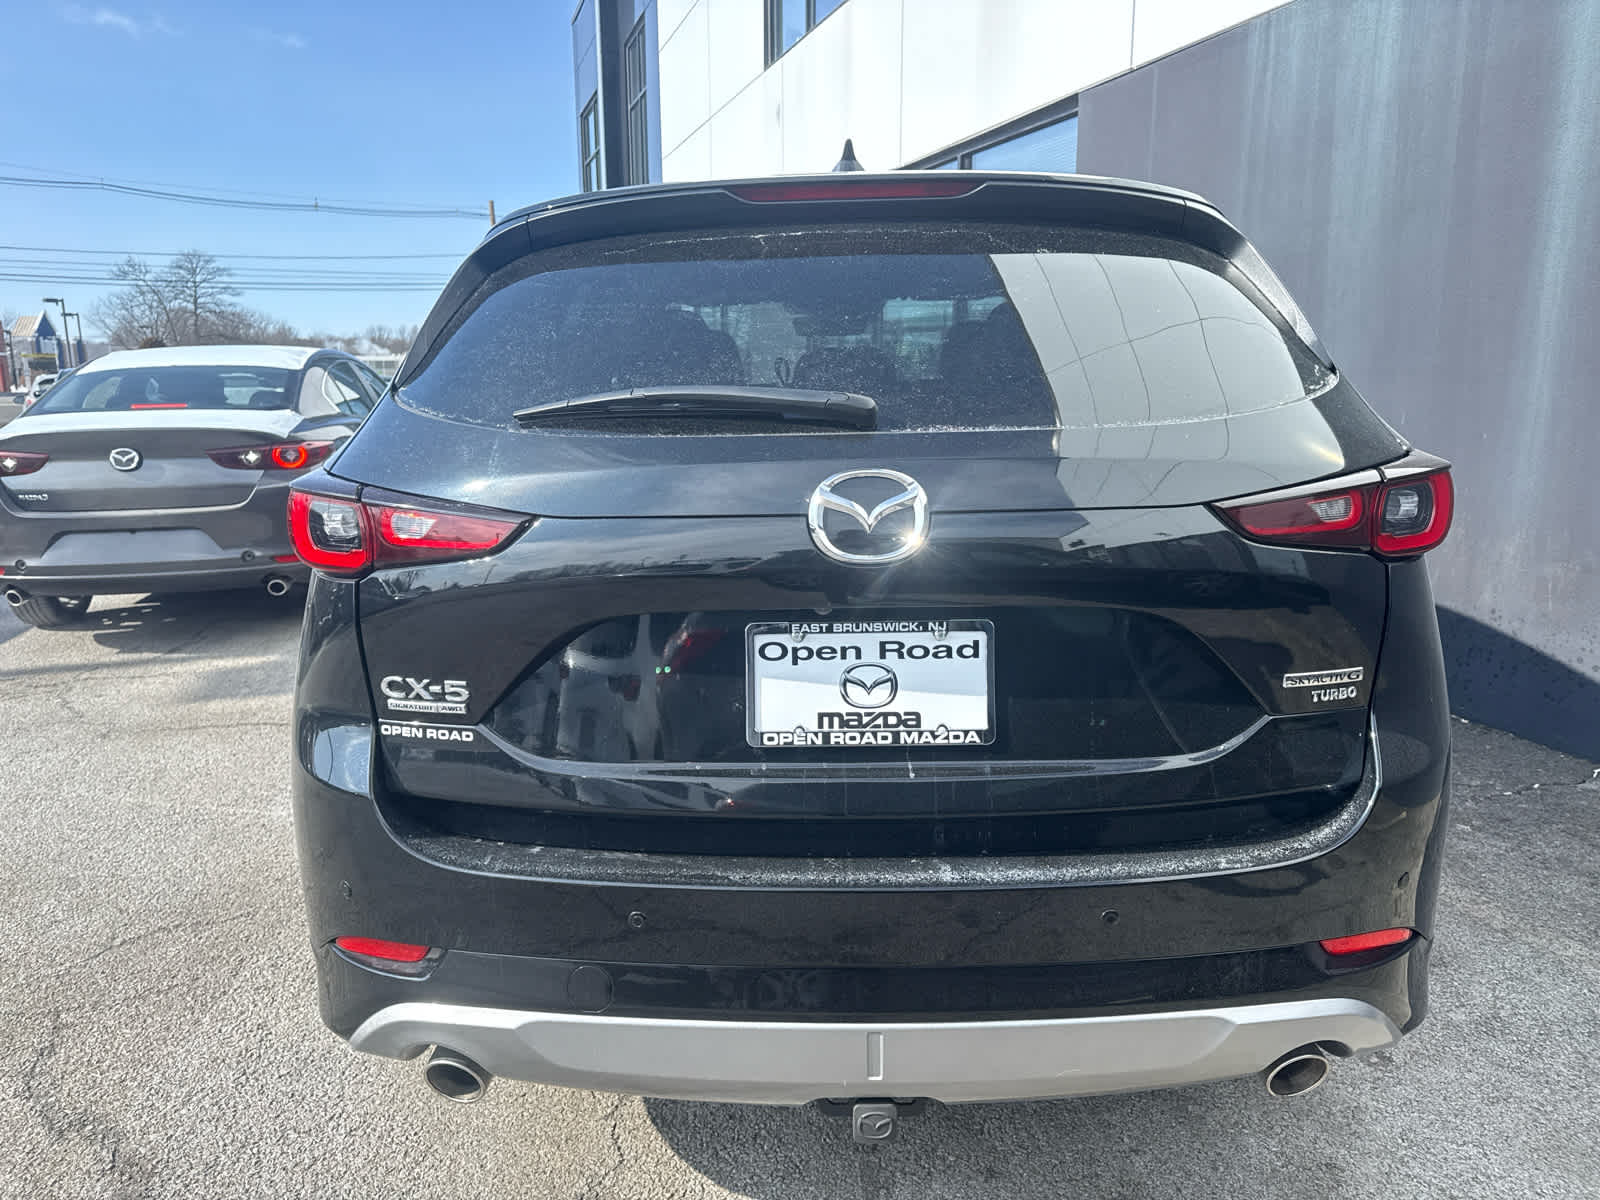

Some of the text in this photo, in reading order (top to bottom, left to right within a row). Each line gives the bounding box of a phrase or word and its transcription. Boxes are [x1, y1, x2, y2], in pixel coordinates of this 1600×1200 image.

[791, 621, 947, 633] EAST BRUNSWICK, NJ
[758, 640, 980, 665] Open Road
[381, 675, 470, 702] CX-5
[1312, 687, 1357, 702] TURBO
[817, 711, 922, 729] mazda
[381, 724, 474, 742] OPEN ROAD
[763, 731, 981, 745] OPEN ROAD MAZDA
